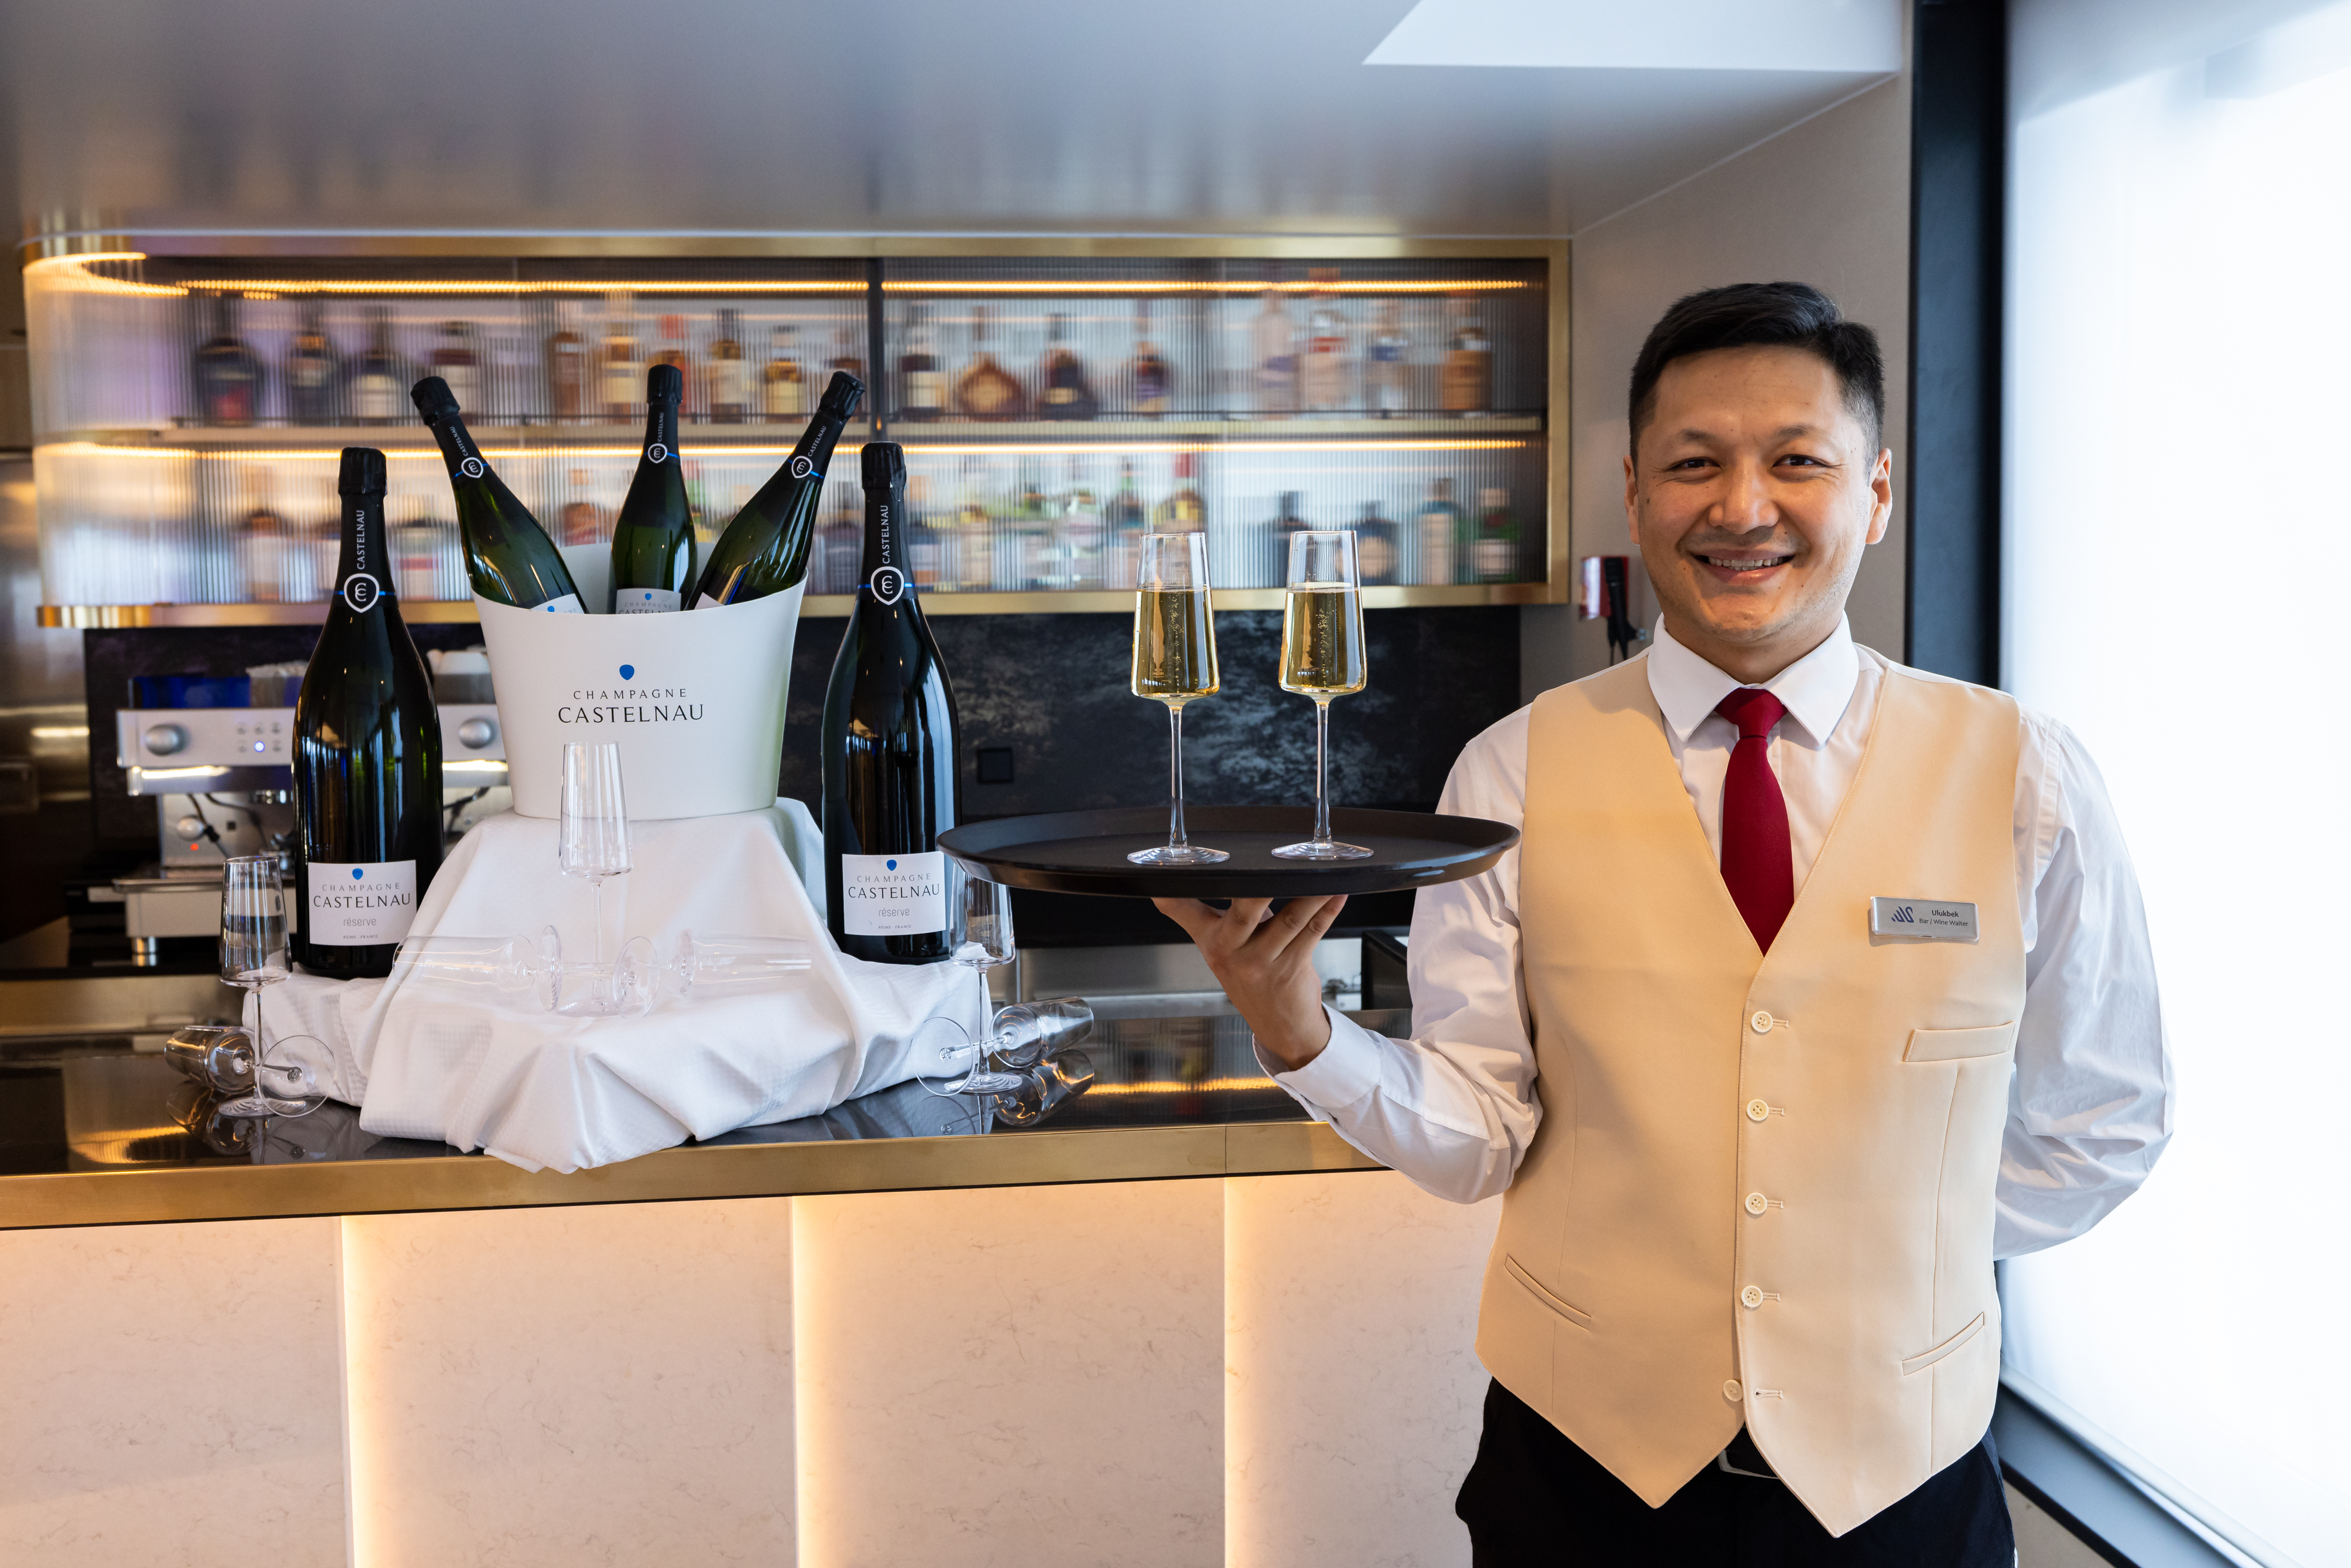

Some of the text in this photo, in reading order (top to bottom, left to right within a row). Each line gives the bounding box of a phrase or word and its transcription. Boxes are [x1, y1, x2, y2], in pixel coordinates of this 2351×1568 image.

[449, 426, 468, 457] CASTELNAU
[808, 425, 826, 457] CASTELNAU
[356, 510, 365, 569] CASTELNAU
[880, 505, 890, 564] CASTELNAU
[573, 688, 686, 700] CHAMPAGNE
[558, 703, 704, 723] CASTELNAU
[857, 873, 931, 883] CHAMPAGNE
[322, 882, 400, 892] CHAMPAGNE
[848, 883, 940, 899] CASTELNAU
[313, 893, 411, 909] CASTELNAU
[878, 907, 910, 917] réserve
[343, 917, 377, 927] réserve
